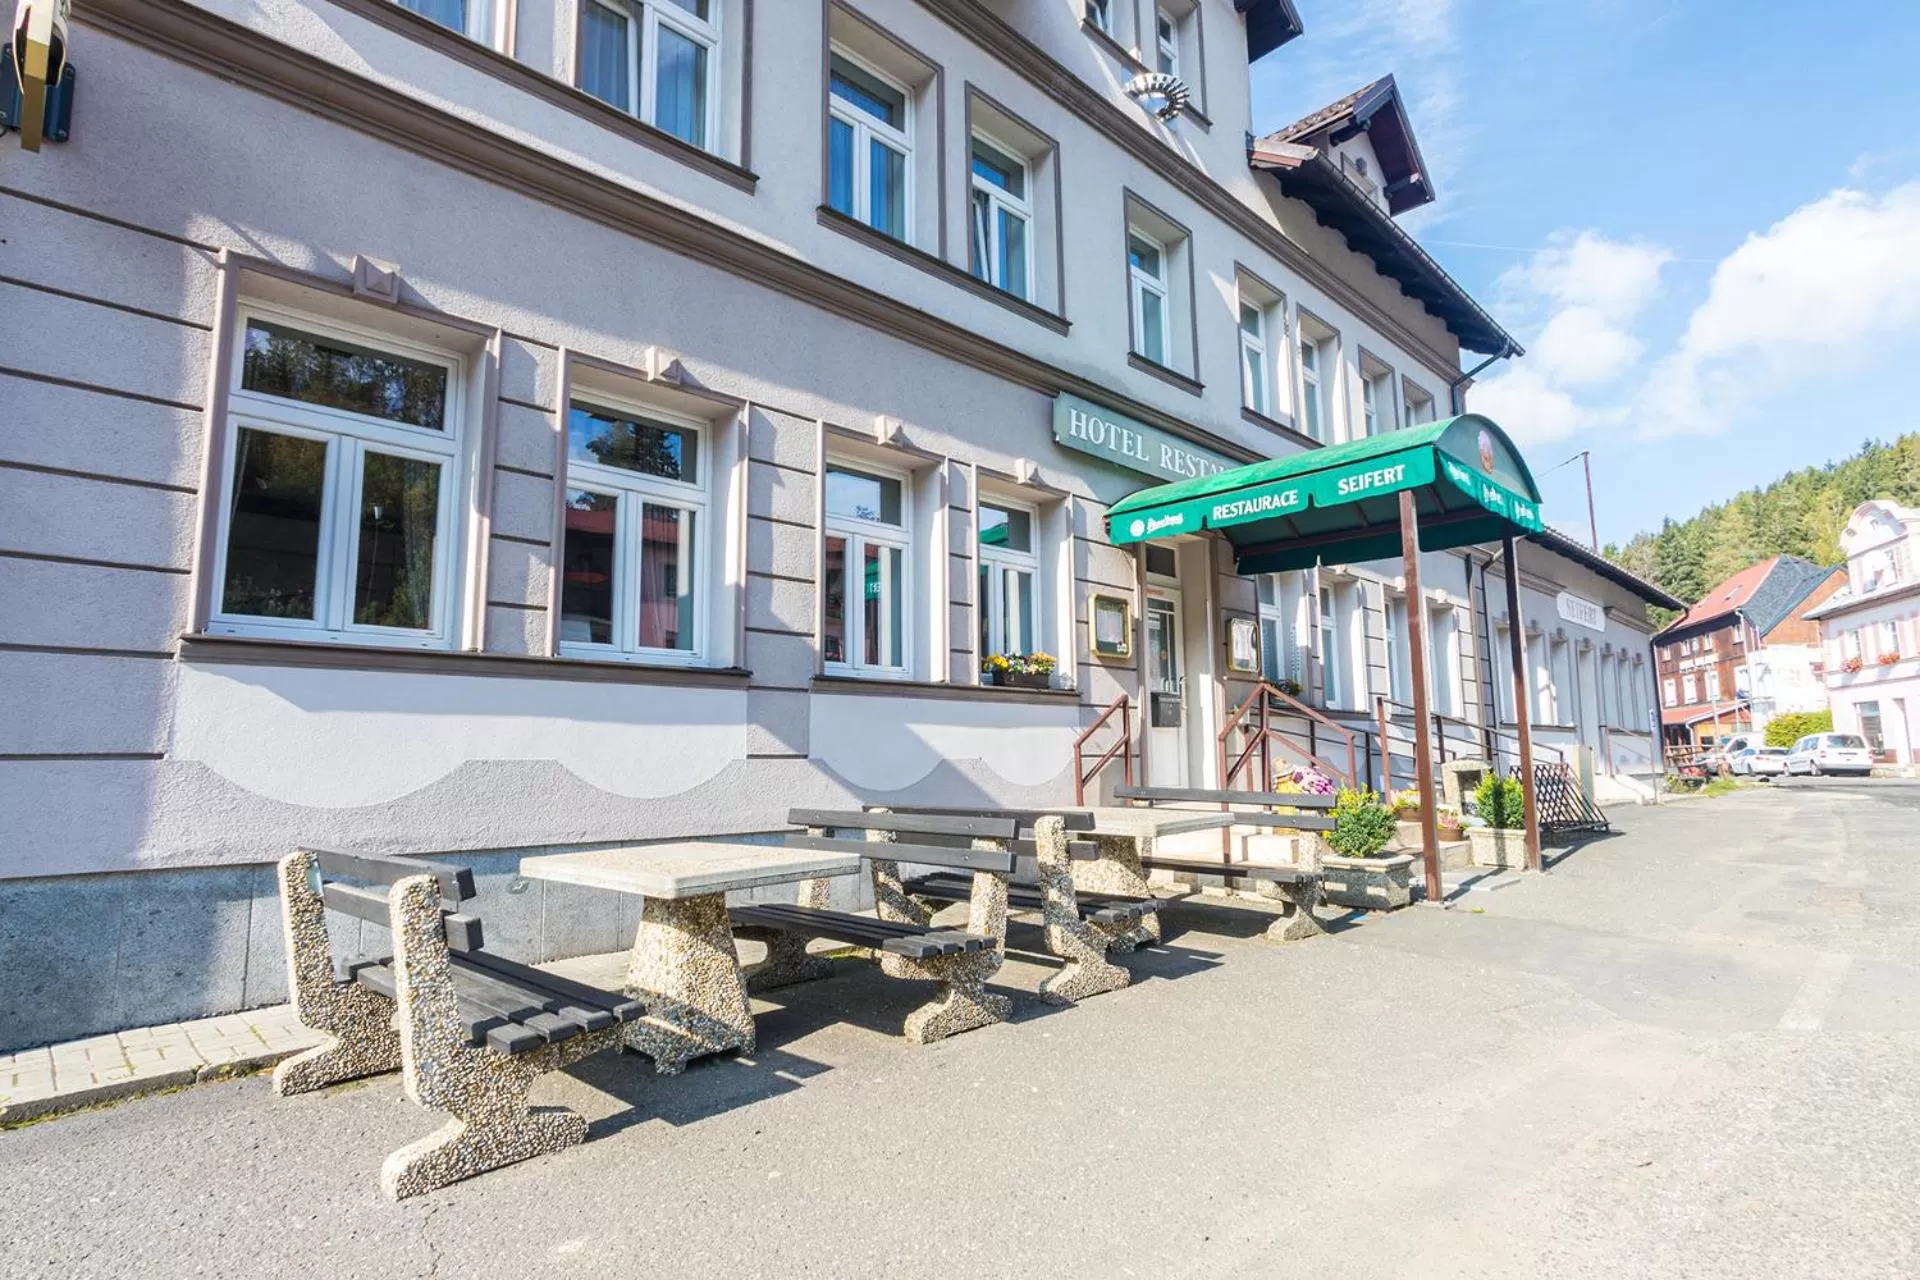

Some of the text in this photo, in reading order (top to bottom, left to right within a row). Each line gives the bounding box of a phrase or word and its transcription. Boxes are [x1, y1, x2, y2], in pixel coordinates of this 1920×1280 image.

[1069, 408, 1149, 461] HOTEL
[1213, 465, 1405, 520] RESTAURACE SEIFERT
